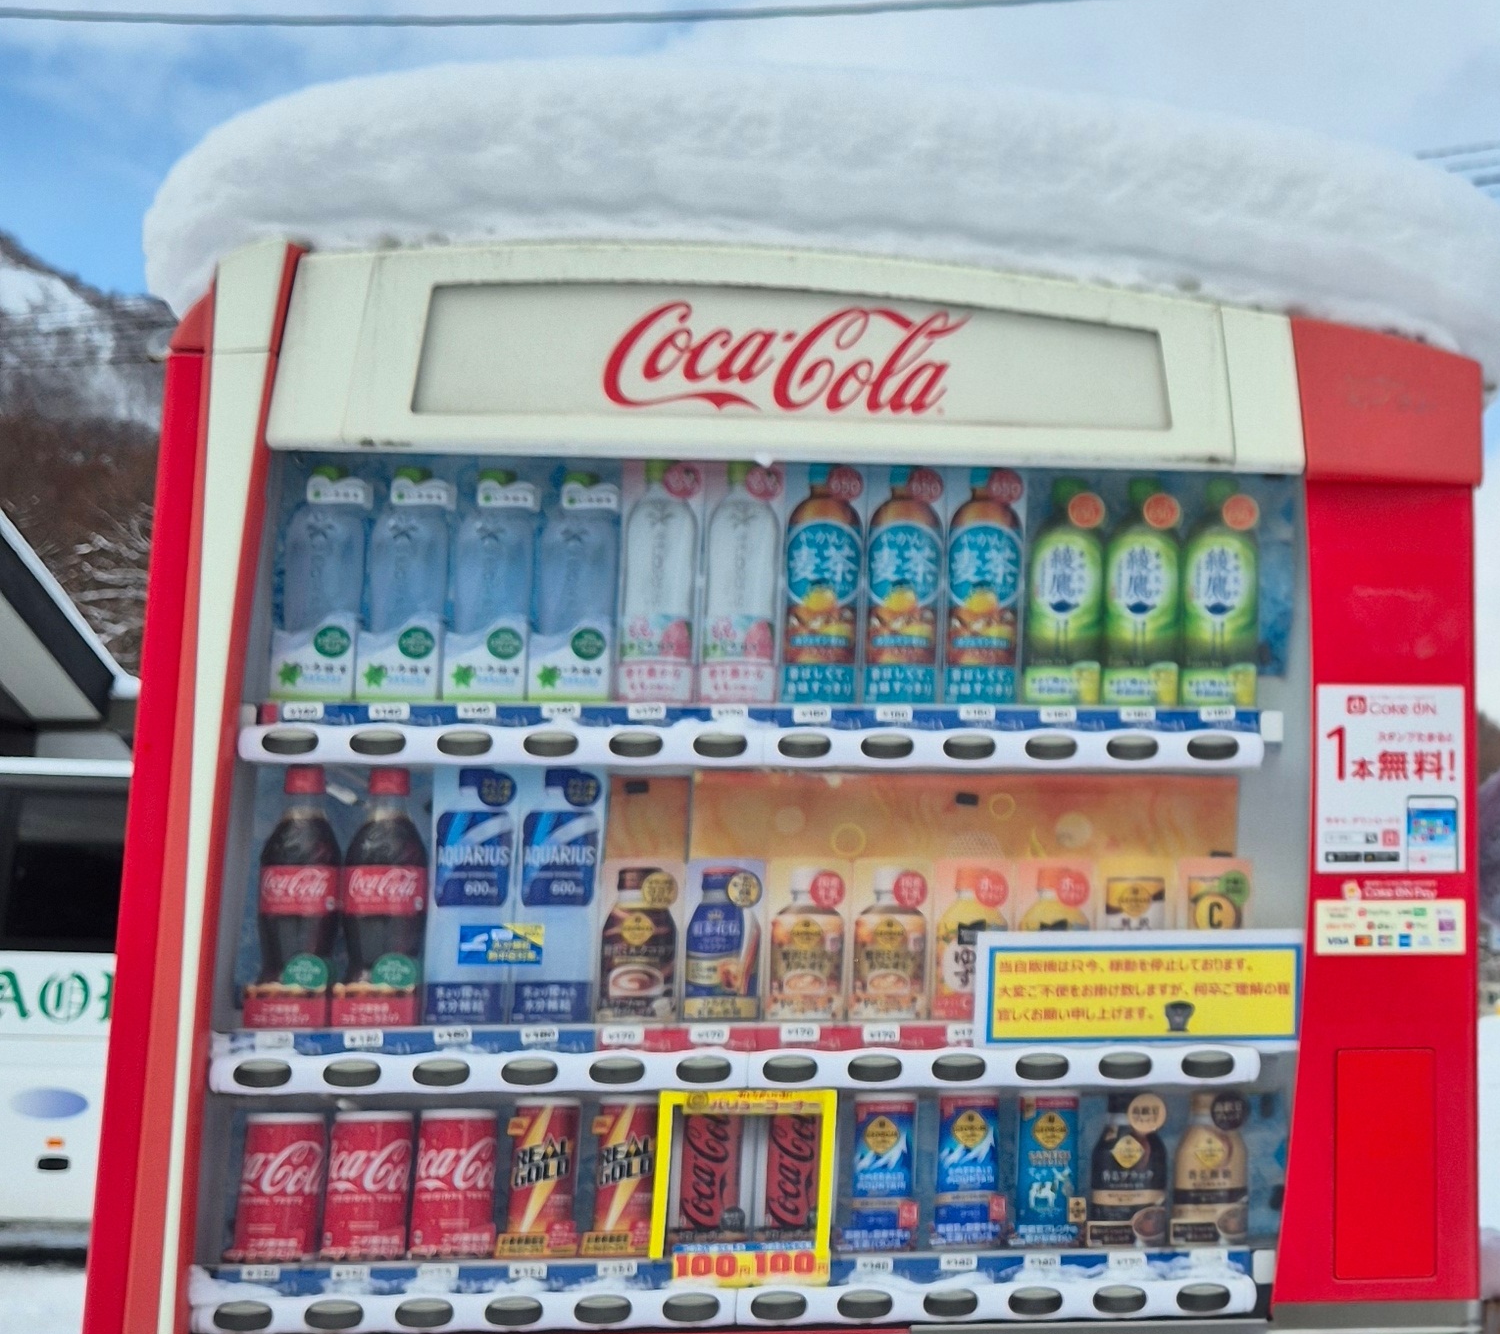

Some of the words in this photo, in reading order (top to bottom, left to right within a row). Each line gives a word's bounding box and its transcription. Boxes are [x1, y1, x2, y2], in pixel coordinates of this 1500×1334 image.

[602, 299, 972, 413] Coca-Cola
[437, 844, 511, 867] AQUARIUS
[523, 844, 597, 867] AQUARIUS
[515, 1135, 568, 1166] REAL
[600, 1134, 651, 1165] REAL
[512, 1154, 571, 1191] GOLD
[598, 1154, 653, 1189] GOLD
[856, 1181, 906, 1191] MOUNTAIN
[946, 1175, 995, 1186] MOUNTAIN
